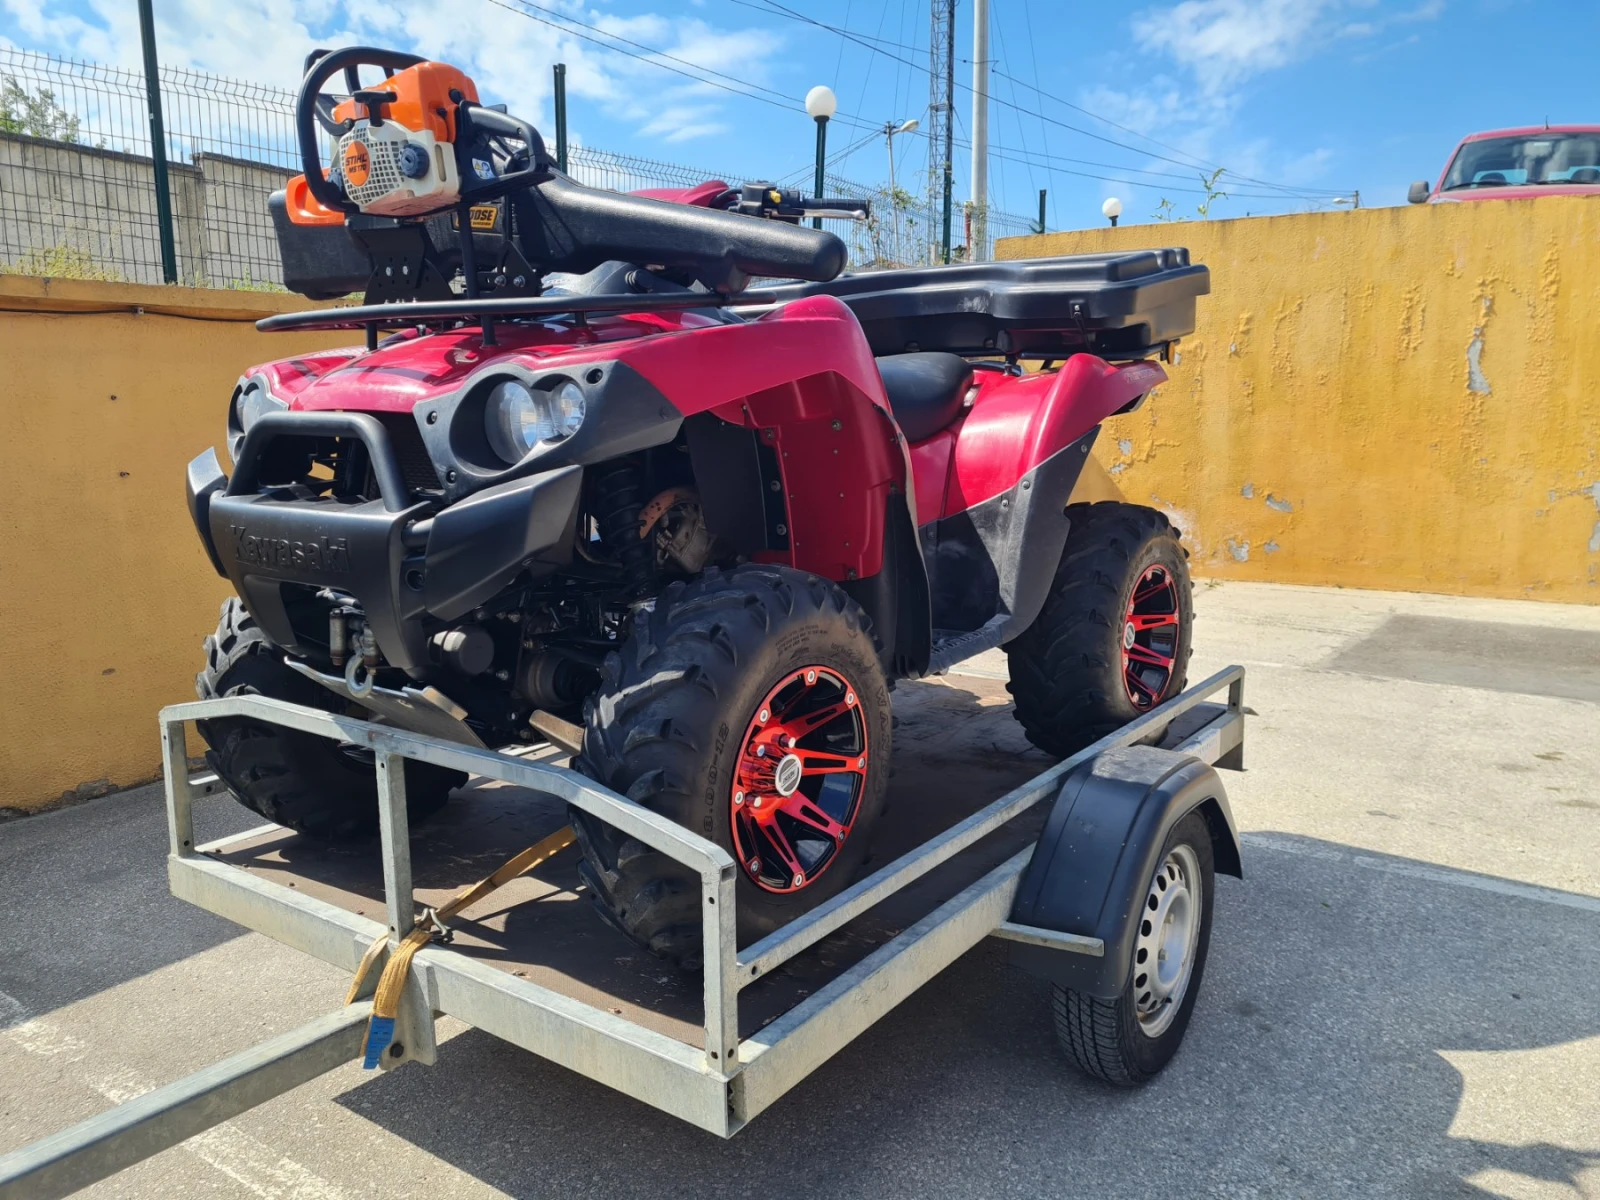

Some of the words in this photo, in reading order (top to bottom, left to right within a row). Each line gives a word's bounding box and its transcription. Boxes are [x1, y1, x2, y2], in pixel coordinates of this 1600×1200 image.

[346, 153, 367, 166] STIHL
[469, 209, 494, 221] OOSE
[230, 525, 350, 573] Kawasaki
